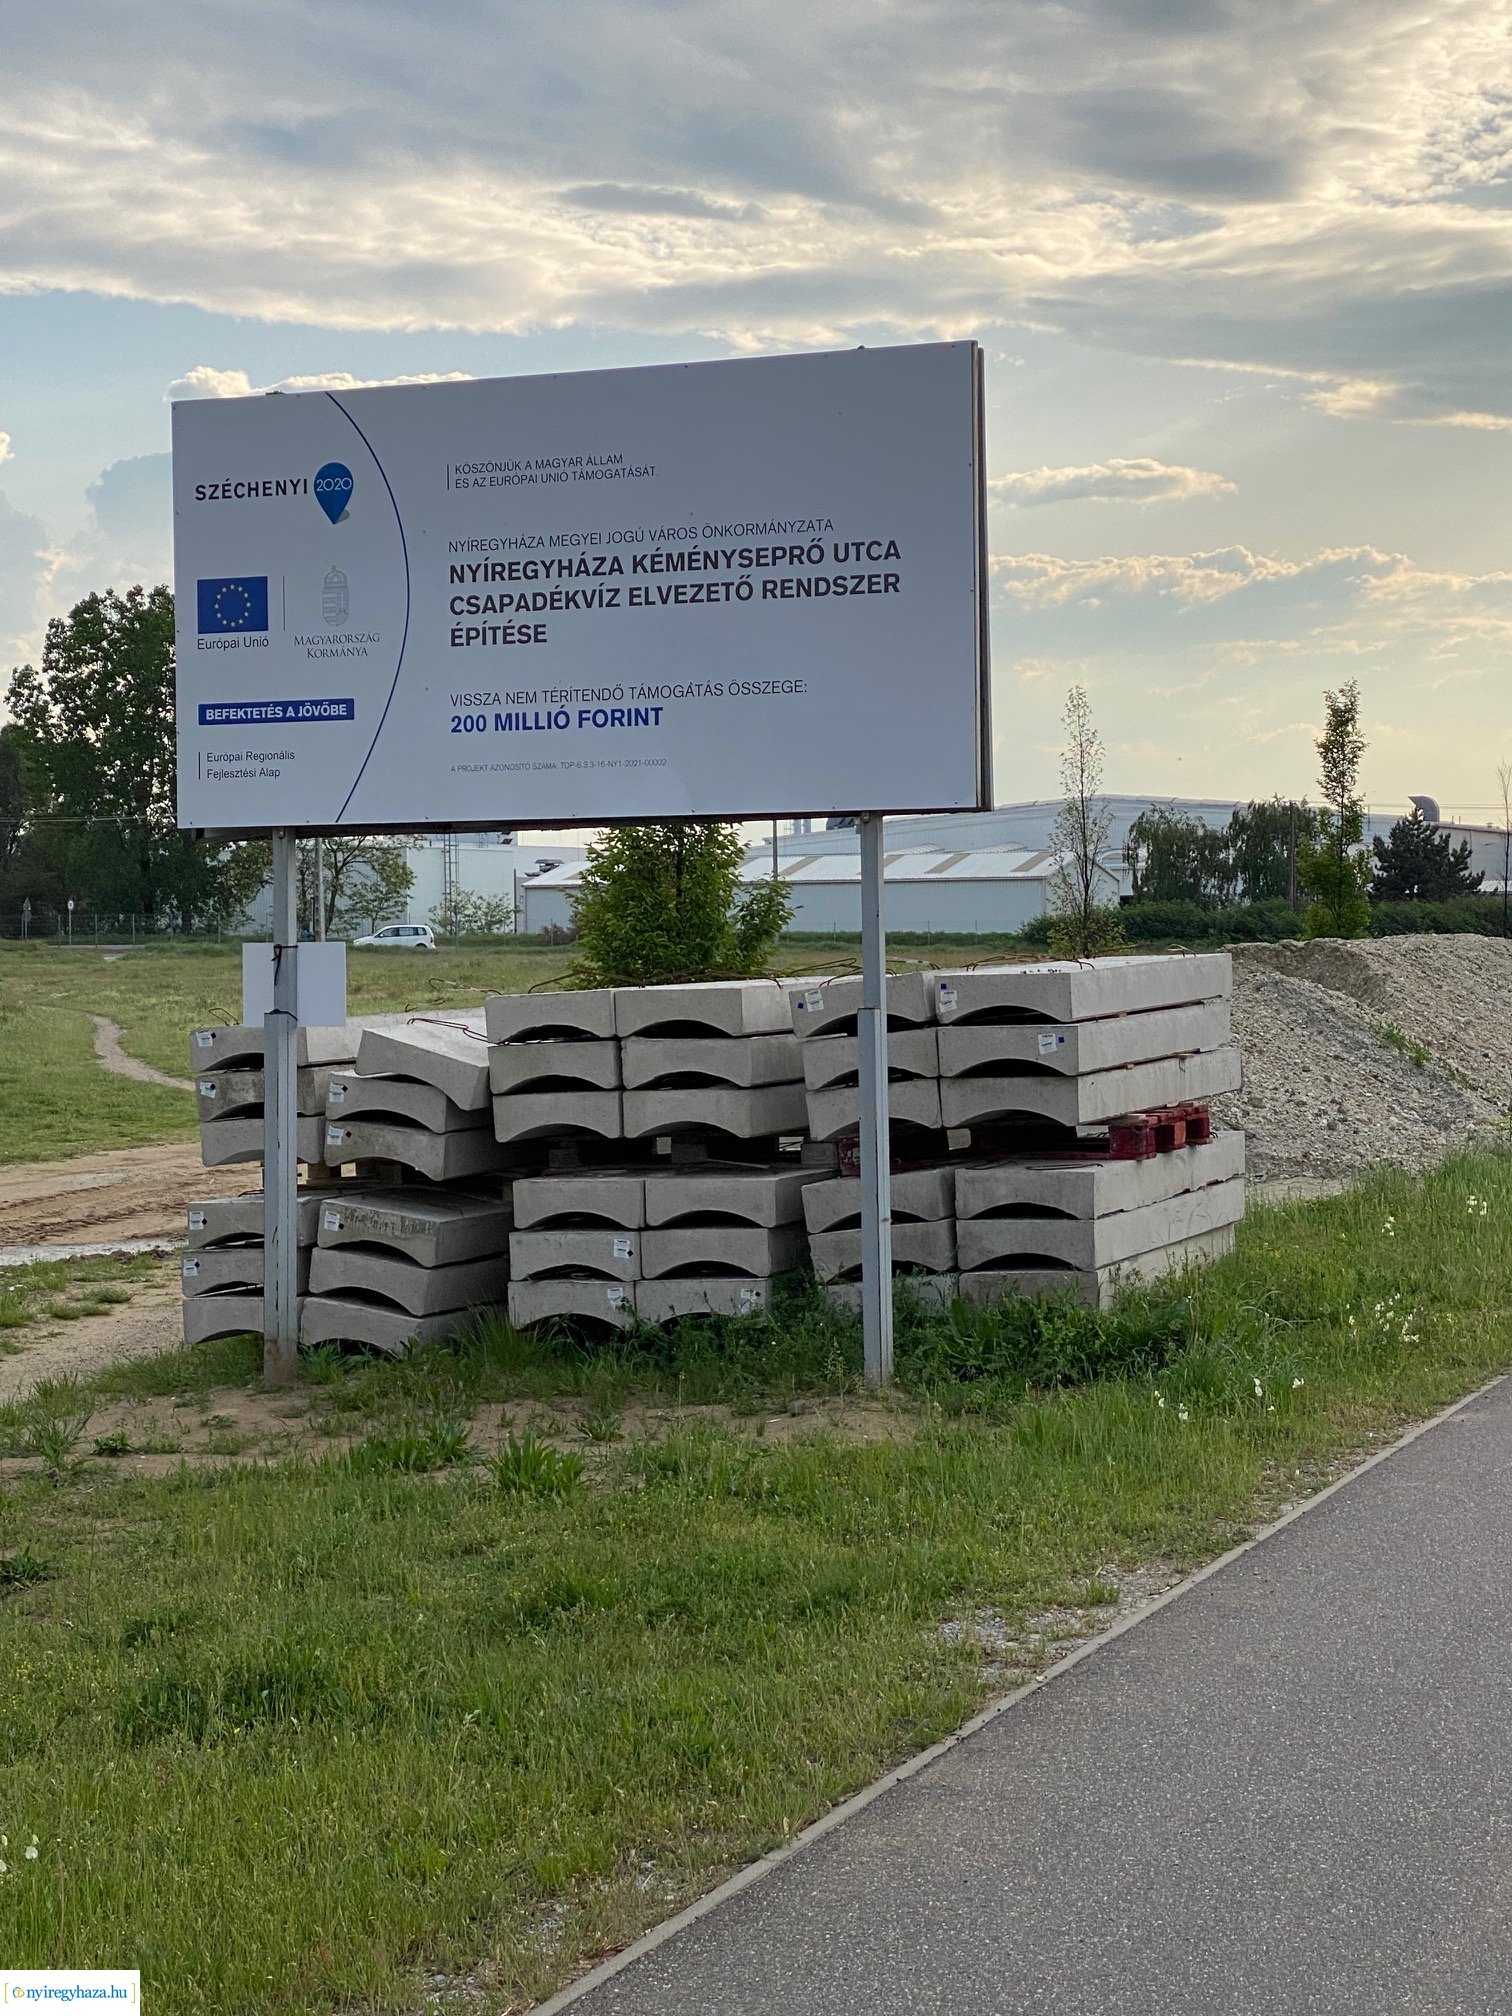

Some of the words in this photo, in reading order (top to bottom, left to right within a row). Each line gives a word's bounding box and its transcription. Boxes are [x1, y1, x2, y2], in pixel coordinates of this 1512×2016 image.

[525, 460, 532, 471] A
[535, 456, 583, 470] MAGYAR
[586, 453, 623, 466] ÁLLAM
[455, 475, 469, 489] ÉS
[472, 477, 486, 488] AZ
[489, 472, 538, 487] EURÓPAI
[541, 469, 569, 484] UNIÓ
[195, 478, 308, 501] SZÉCHENYI
[316, 477, 352, 492] 2020
[449, 533, 545, 553] NYÍREGYHÁZA
[549, 533, 602, 548] MEGYEI
[606, 526, 644, 544] JOGÚ
[649, 525, 698, 541] VÁROS
[702, 518, 834, 539] ÖNKORMÁNYZATA
[450, 551, 624, 583] NYÍREGYHÁZA
[632, 537, 825, 574] KÉMÉNYSEPRŐ
[833, 540, 901, 563] UTCA
[450, 582, 620, 616] CSAPADÉKVÍZ
[628, 574, 753, 607] ELVEZETŐ
[762, 573, 901, 600] RENDSZER
[294, 631, 380, 646] MAGYARORSZÁG
[450, 619, 548, 647] ÉPÍTÉSE
[197, 637, 240, 651] Európai
[243, 635, 269, 648] Unió
[307, 646, 368, 659] KORMÁNYA
[450, 692, 501, 707] VISSZA
[506, 691, 537, 705] NEM
[542, 683, 624, 703] TÉRÍTENDŐ
[728, 679, 808, 696] ÖSSZEGE:
[206, 704, 283, 720] BEFEKTETÉS
[286, 706, 295, 717] A
[298, 702, 347, 717] JÖVŐBE
[451, 714, 487, 733] 200
[494, 704, 570, 732] MILLIÓ
[578, 707, 664, 729] FORINT
[206, 751, 243, 763] Európai
[245, 749, 295, 763] Regionális
[206, 768, 256, 781] Fejlesztési
[258, 767, 281, 780] Alap
[457, 764, 488, 773] PROJEKT
